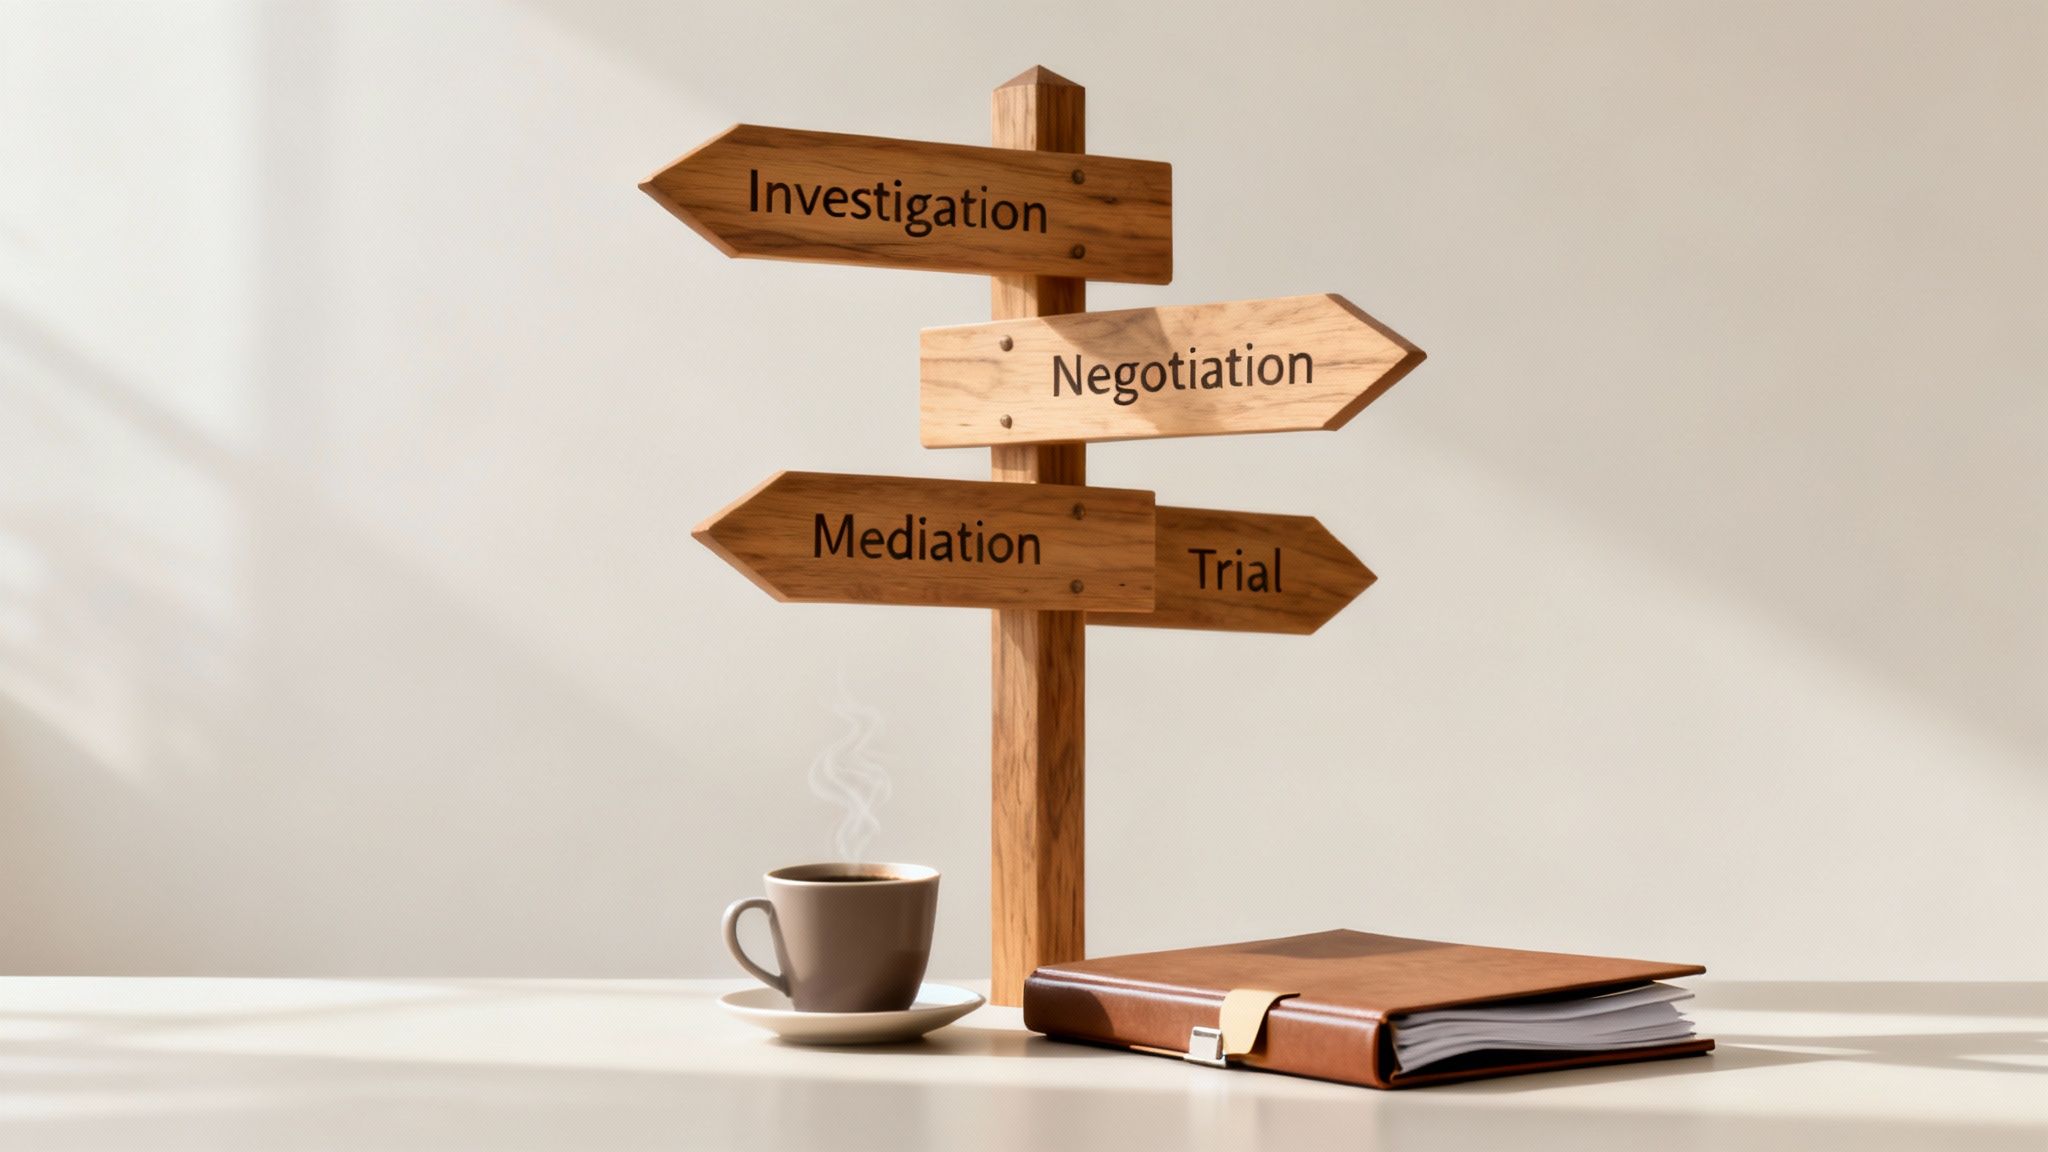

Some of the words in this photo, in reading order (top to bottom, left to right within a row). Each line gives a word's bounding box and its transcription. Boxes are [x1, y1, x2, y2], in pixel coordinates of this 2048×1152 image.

[749, 168, 1048, 238] Investigation
[1053, 342, 1313, 406] Negotiation
[813, 513, 1041, 565] Mediation
[1187, 546, 1283, 594] Trial
